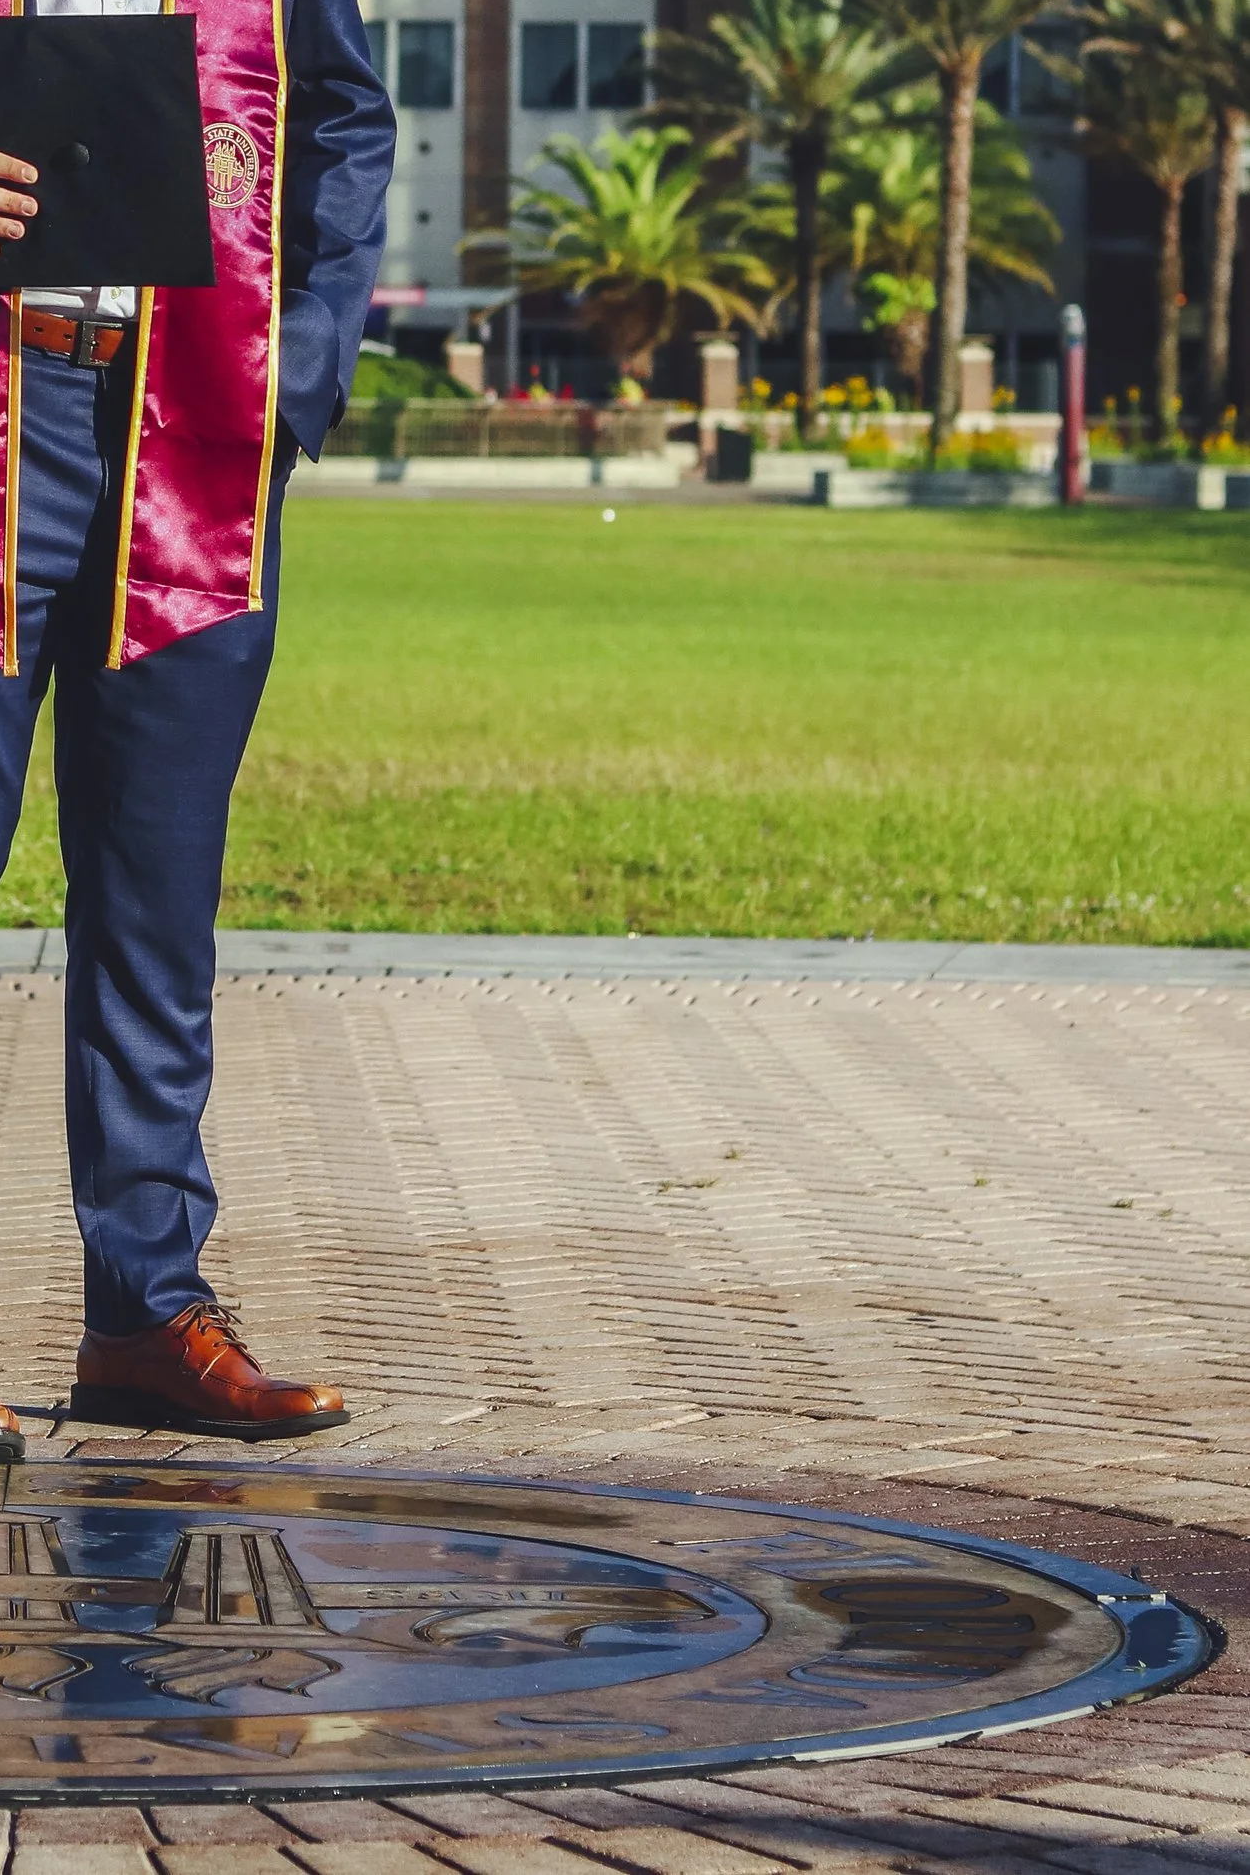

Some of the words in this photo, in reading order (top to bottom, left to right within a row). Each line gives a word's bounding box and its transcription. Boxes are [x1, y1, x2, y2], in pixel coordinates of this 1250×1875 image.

[207, 128, 235, 140] STATE
[235, 134, 255, 194] UNIVERSITY
[213, 192, 231, 204] 1851
